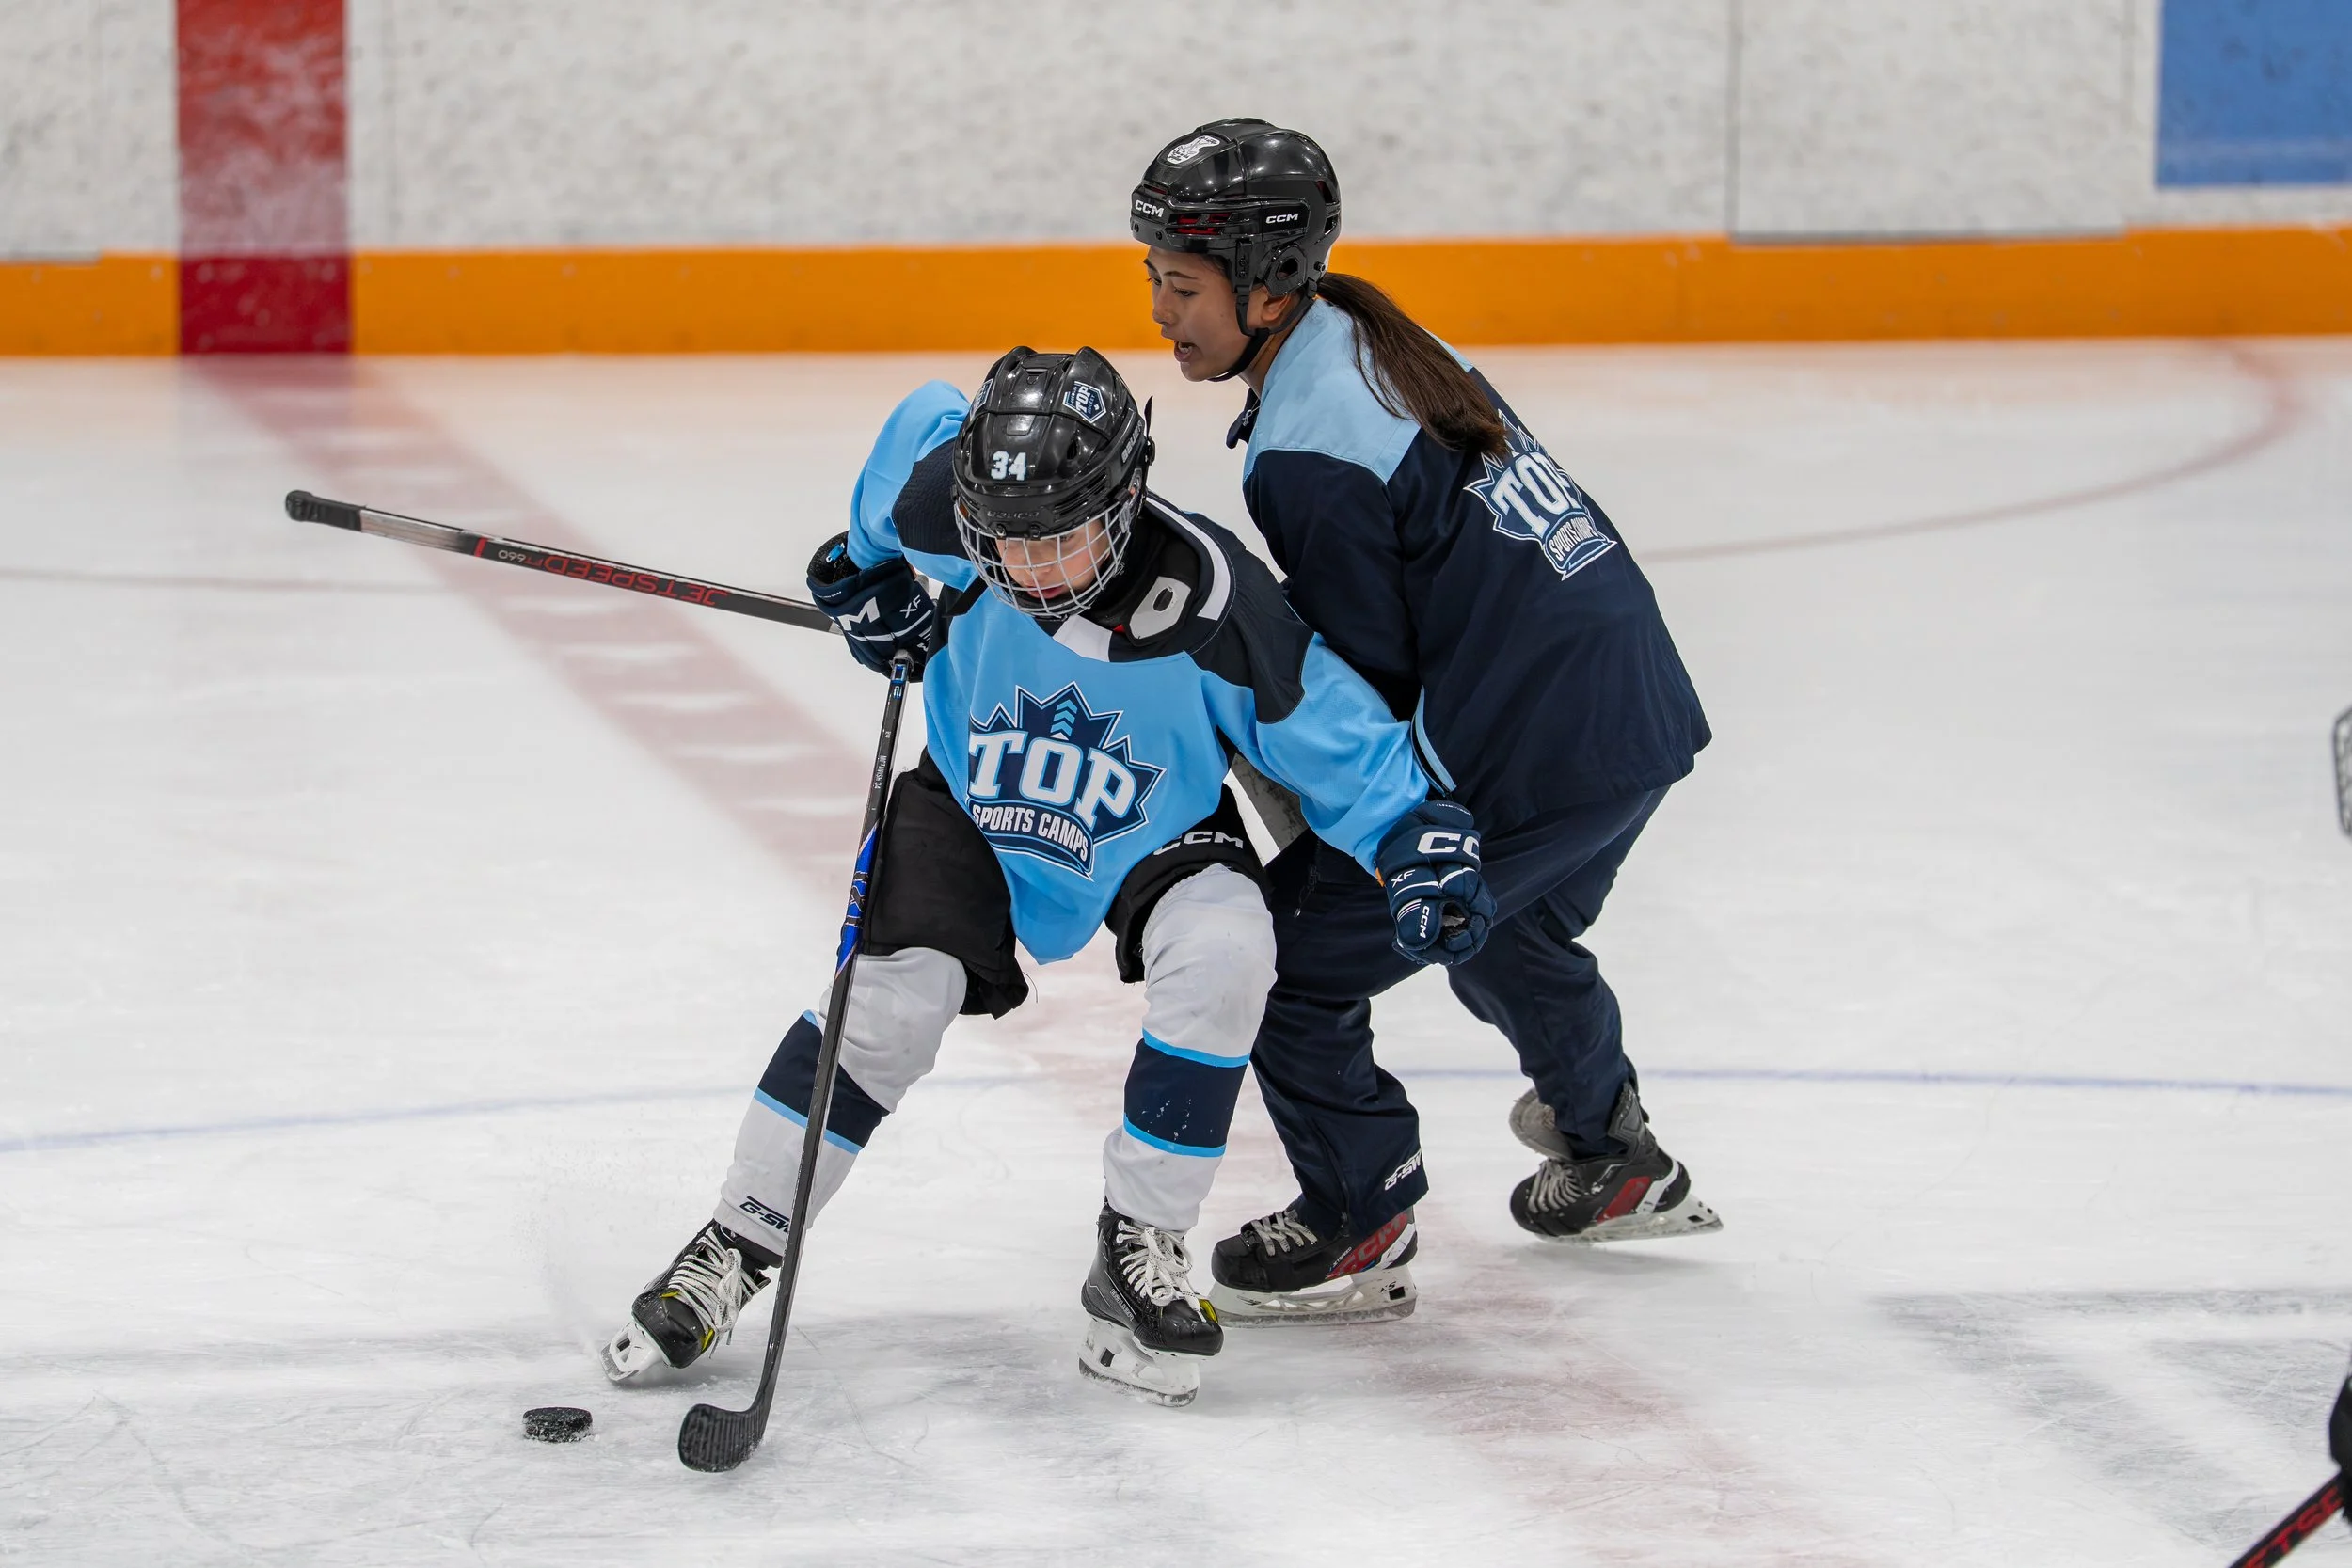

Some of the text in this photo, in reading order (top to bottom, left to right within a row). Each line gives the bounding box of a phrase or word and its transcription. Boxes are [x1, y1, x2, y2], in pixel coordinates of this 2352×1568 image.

[1135, 199, 1165, 217] CCM
[1265, 213, 1299, 224] CCM
[1075, 386, 1091, 414] TOP
[990, 451, 1027, 481] 34
[1491, 452, 1583, 539] TOP
[1549, 521, 1578, 562] SPORTS
[543, 554, 730, 607] JETSPEED
[831, 597, 881, 631] M
[899, 594, 922, 619] XF
[969, 730, 1136, 832] TOP
[972, 805, 1089, 862] SPORTS CAMPS
[1391, 869, 1416, 889] XF
[1419, 905, 1430, 939] CCM
